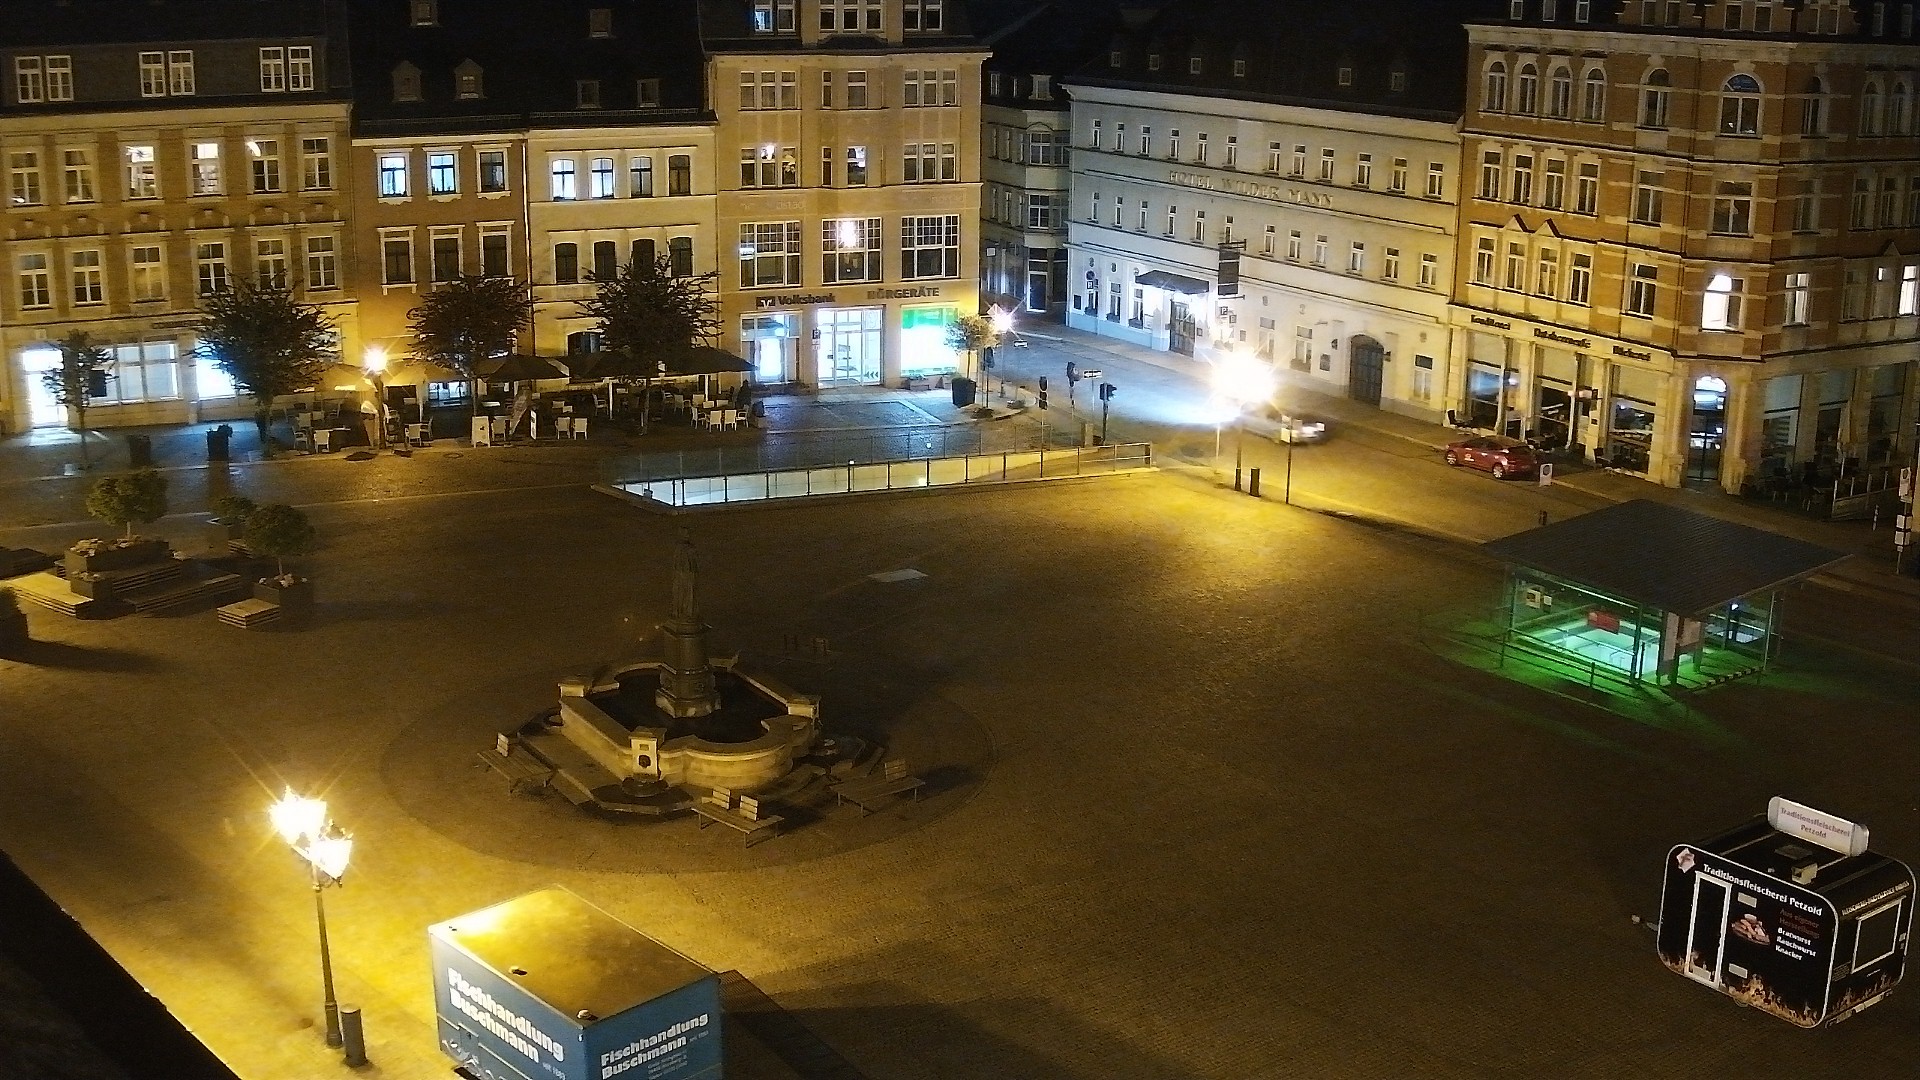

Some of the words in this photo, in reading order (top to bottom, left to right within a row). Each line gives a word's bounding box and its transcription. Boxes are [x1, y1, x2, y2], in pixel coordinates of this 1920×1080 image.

[1170, 170, 1214, 190] HOTEL
[1222, 178, 1280, 200] WILDER
[1288, 188, 1334, 208] MANN
[777, 293, 836, 305] Volksbank
[1781, 807, 1850, 837] Traditionsfleischerei
[1800, 824, 1827, 838] Petzold
[1703, 863, 1788, 904] Traditionsfleischerei
[1789, 896, 1823, 916] Petzold
[1777, 927, 1812, 946] Bratwurst
[447, 967, 565, 1062] Fischhandlung
[449, 988, 539, 1063] Buschmann
[600, 1013, 709, 1067] Fischhandlung
[601, 1036, 687, 1080] Buschmann
